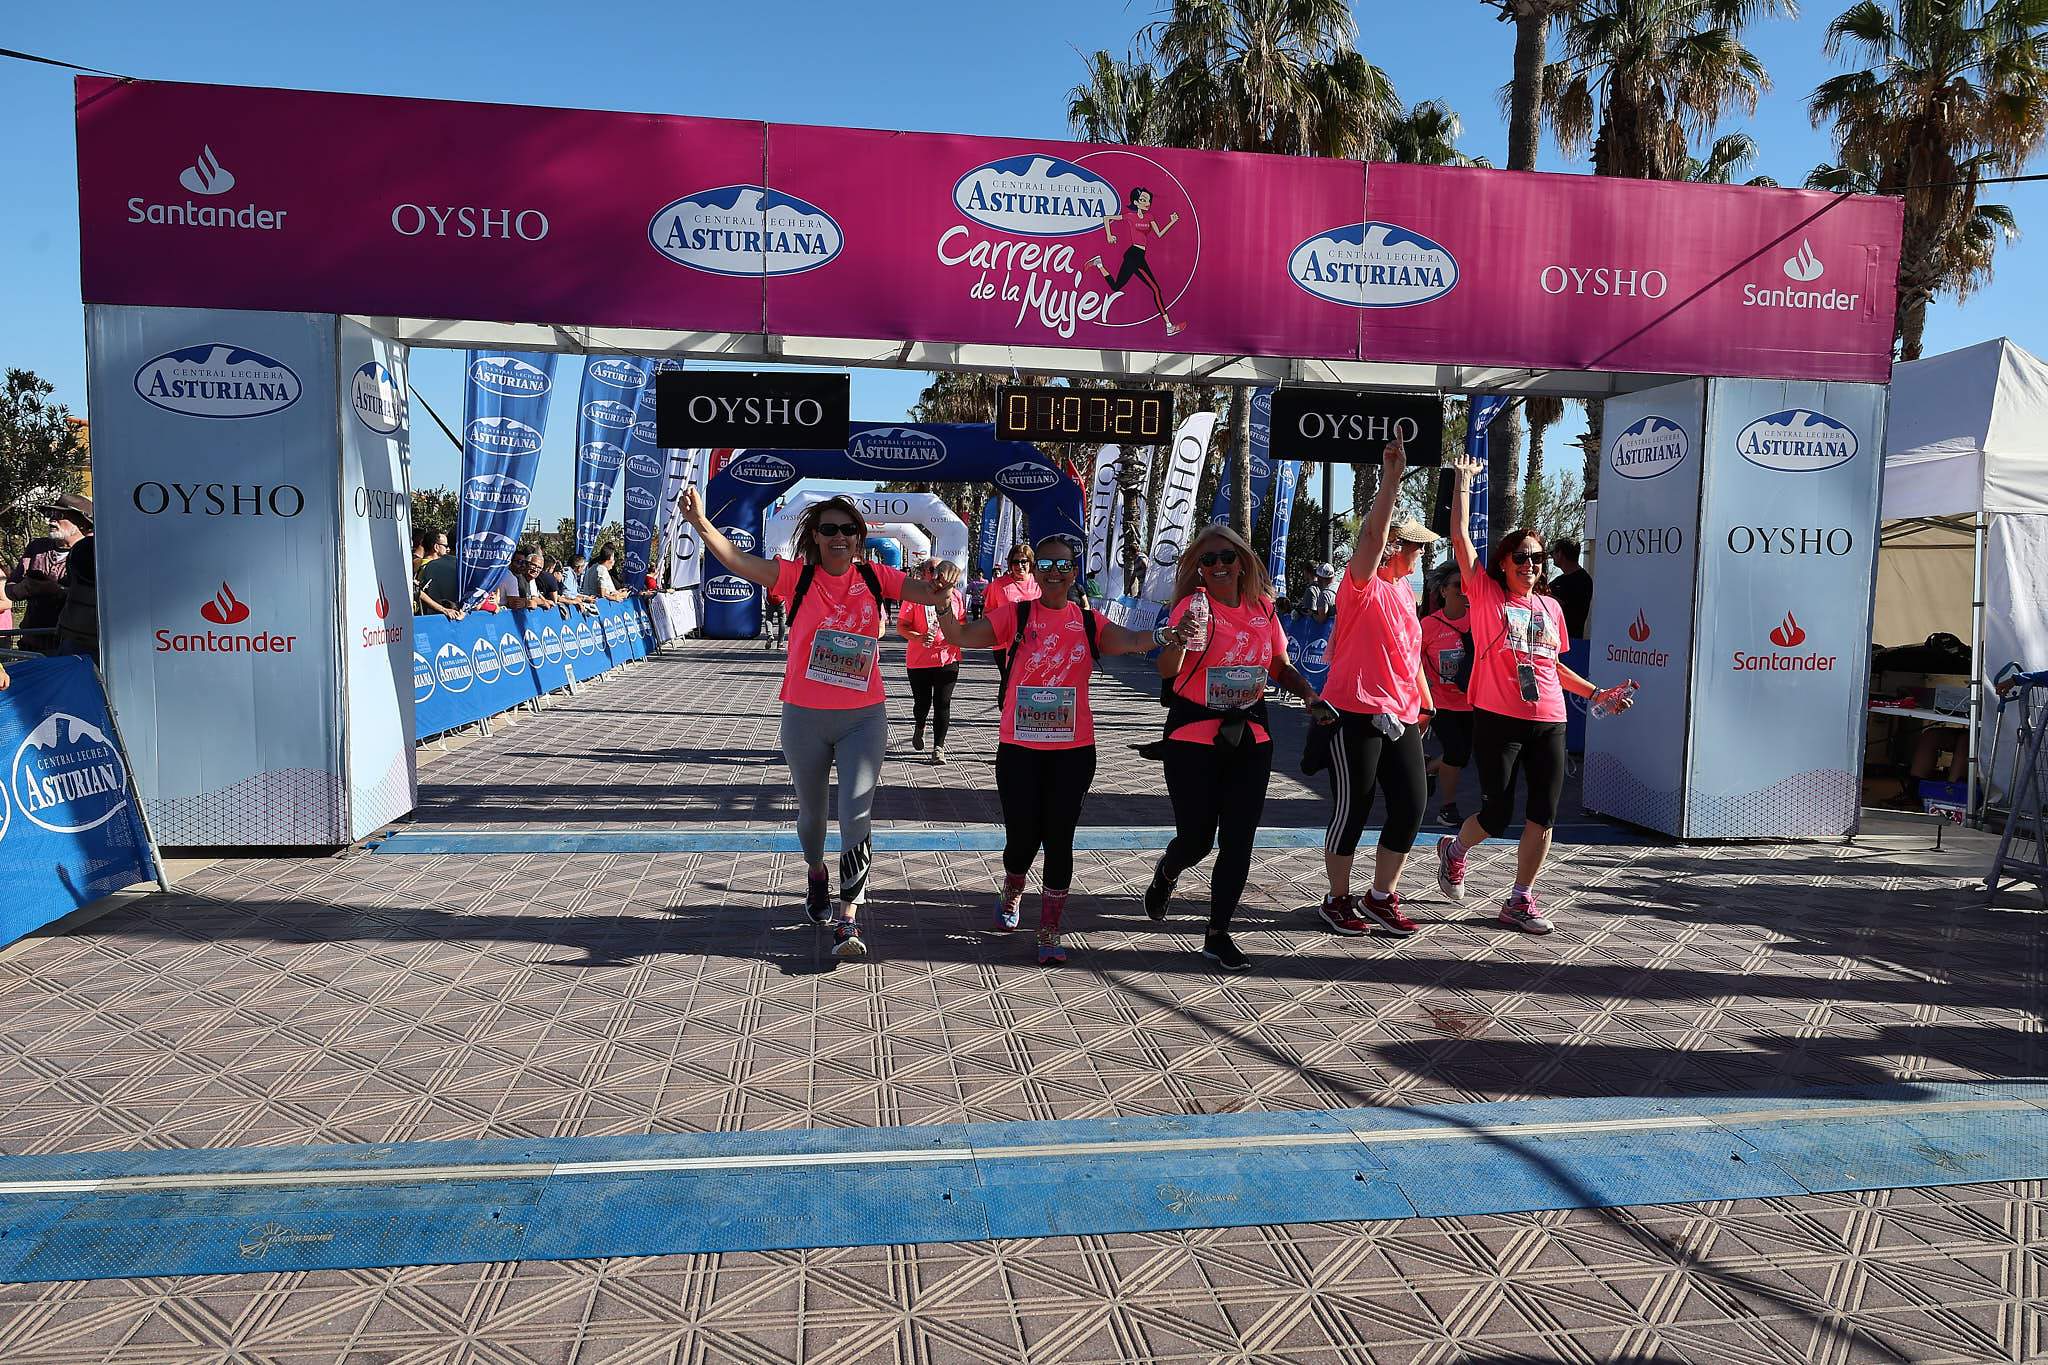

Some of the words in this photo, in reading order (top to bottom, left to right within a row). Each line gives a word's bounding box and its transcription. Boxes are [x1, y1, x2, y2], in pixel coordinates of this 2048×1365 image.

[965, 180, 1107, 218] ASTURIANA
[992, 179, 1045, 191] CENTRAL
[1050, 183, 1104, 195] LECHERA
[127, 197, 287, 230] Santander
[391, 203, 549, 241] OYSHO
[694, 214, 755, 226] CENTRAL
[761, 217, 823, 229] LECHERA
[663, 215, 829, 255] ASTURIANA
[937, 225, 1076, 274] Carrera
[1328, 249, 1380, 260] CENTRAL
[1387, 252, 1441, 263] LECHERA
[1301, 250, 1446, 288] ASTURIANA
[1539, 265, 1668, 299] OYSHO
[970, 271, 996, 300] de
[1001, 271, 1020, 302] la
[1014, 270, 1126, 339] Mujer
[1742, 283, 1859, 311] Santander
[148, 369, 290, 401] ASTURIANA
[173, 368, 226, 378] CENTRAL
[231, 369, 284, 380] LECHERA
[474, 365, 544, 391] ASTURIANA
[594, 365, 642, 385] ASTURIANA
[688, 395, 823, 426] OYSHO
[1009, 395, 1160, 435] 01:07:20
[470, 425, 537, 449] ASTURIANA
[1298, 412, 1419, 443] OYSHO
[1626, 437, 1651, 447] CENTRAL
[1652, 433, 1681, 444] LECHERA
[1764, 430, 1803, 438] CENTRAL
[1806, 431, 1846, 439] LECHERA
[851, 439, 939, 460] ASTURIANA
[1615, 442, 1682, 467] ASTURIANA
[1744, 430, 1849, 458] ASTURIANA
[734, 465, 791, 478] ASTURIANA
[1000, 473, 1055, 484] ASTURIANA
[133, 481, 305, 518] OYSHO
[354, 486, 405, 521] OYSHO
[465, 485, 527, 506] ASTURIANA
[851, 498, 909, 516] YSHO
[1153, 435, 1202, 567] OYSHO
[1089, 463, 1117, 574] OYSHO
[1607, 527, 1683, 555] OYSHO
[1727, 525, 1853, 556] OYSHO
[707, 585, 751, 596] ASTURIANA
[154, 629, 297, 653] Santander
[362, 624, 403, 648] Santander
[1606, 644, 1669, 668] Santander
[1732, 651, 1837, 671] Santander
[440, 663, 471, 682] ASTURIANA
[37, 753, 76, 770] CENTRAL
[25, 763, 121, 812] ASTURIAN
